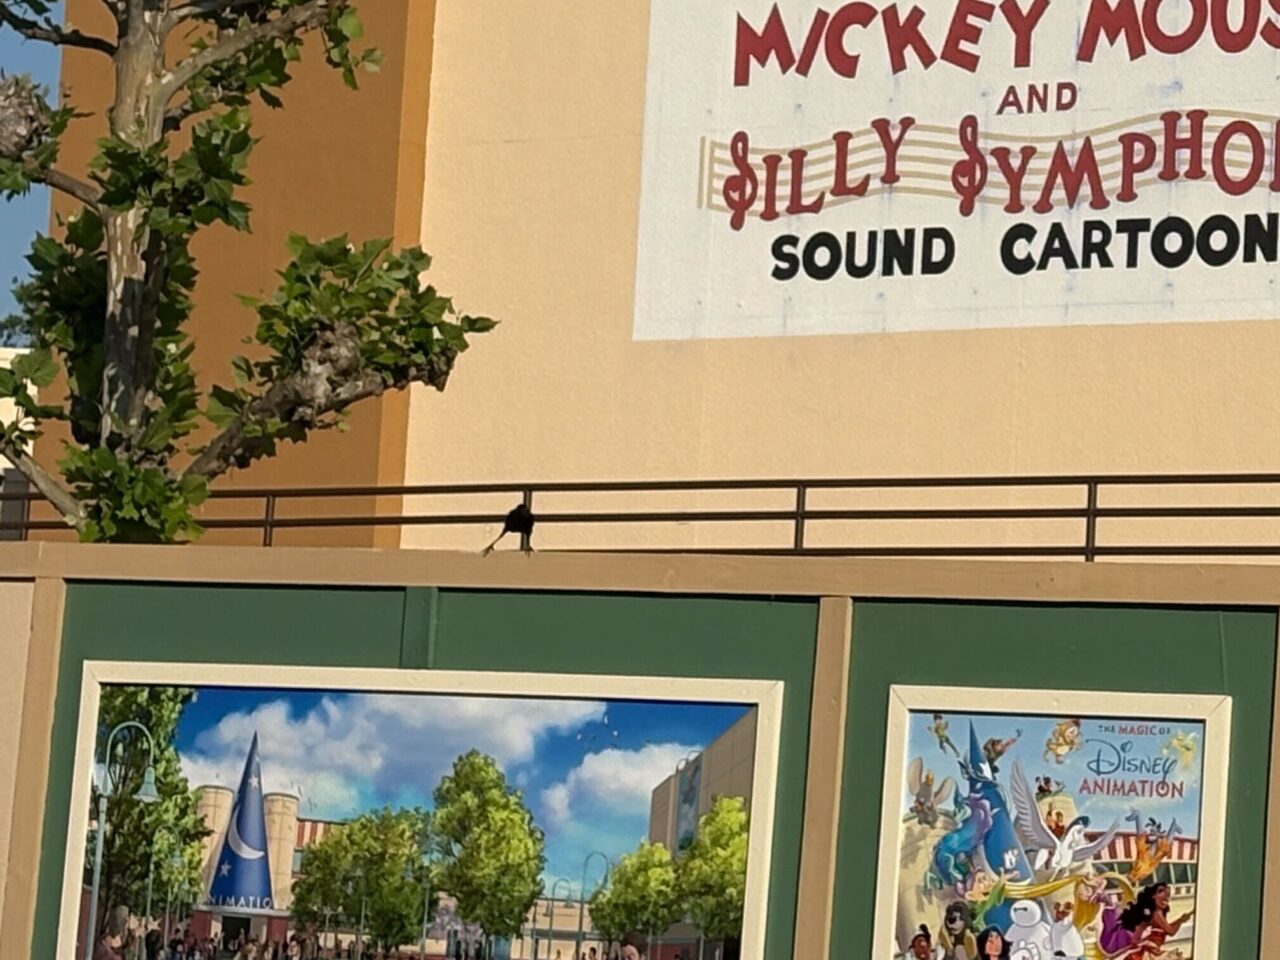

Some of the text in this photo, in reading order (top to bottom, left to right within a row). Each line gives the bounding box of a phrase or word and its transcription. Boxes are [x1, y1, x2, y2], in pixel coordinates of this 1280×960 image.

[996, 81, 1079, 116] AND
[722, 114, 917, 232] SILLY
[770, 226, 957, 281] SOUND
[1118, 725, 1157, 736] MAGIC
[1079, 778, 1184, 799] ANIMATION
